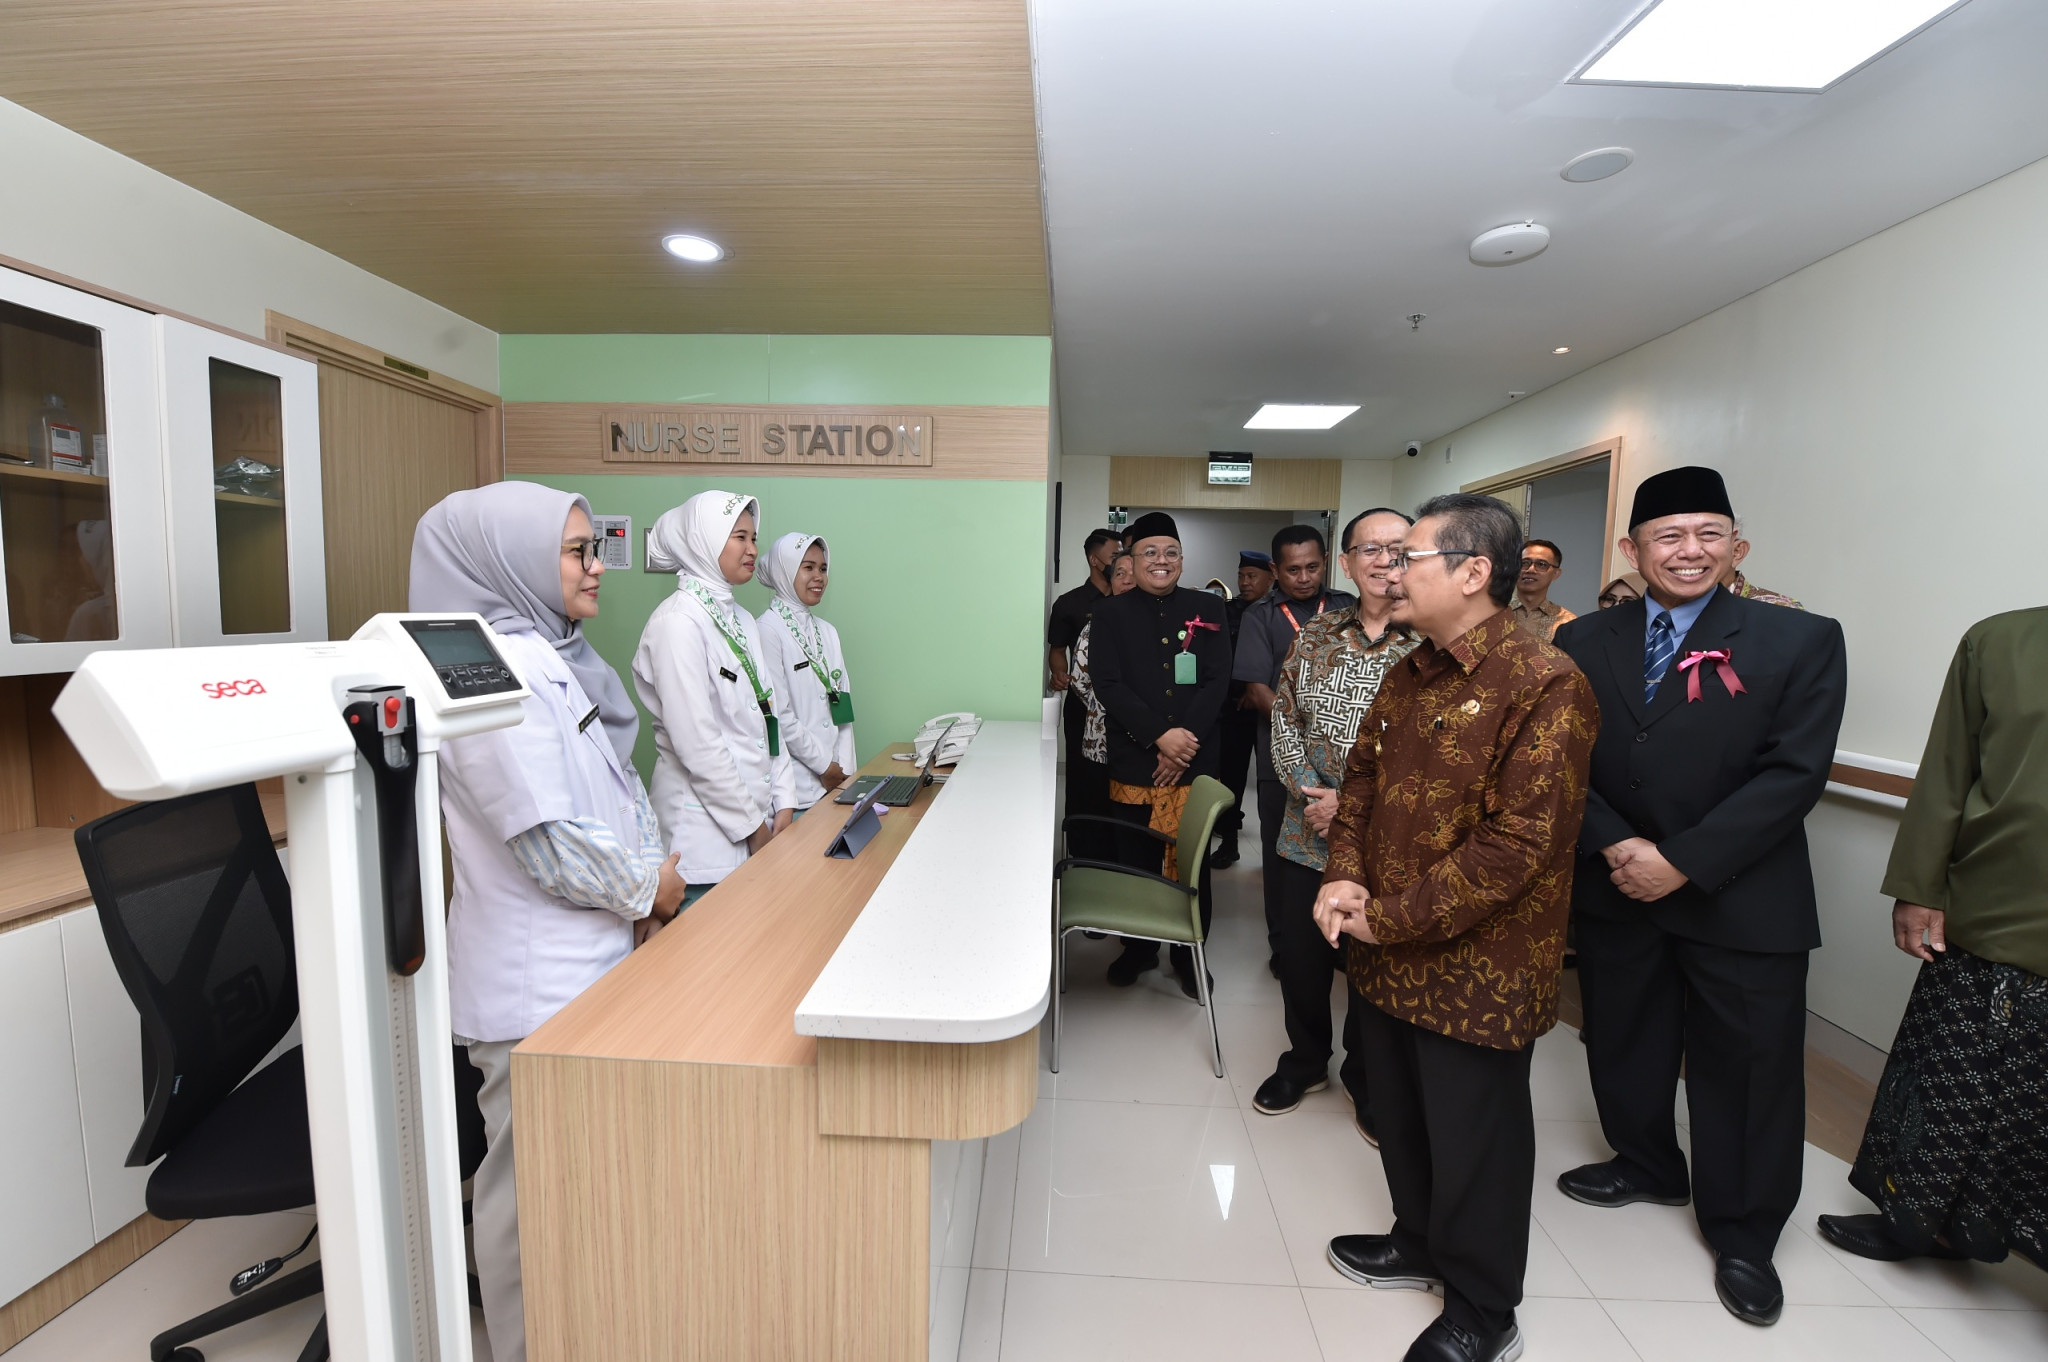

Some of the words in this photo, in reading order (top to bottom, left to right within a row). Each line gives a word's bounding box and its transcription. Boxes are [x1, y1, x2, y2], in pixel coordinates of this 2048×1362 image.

[611, 421, 740, 454] NURSE
[762, 423, 921, 456] STATION
[202, 679, 267, 699] seca
